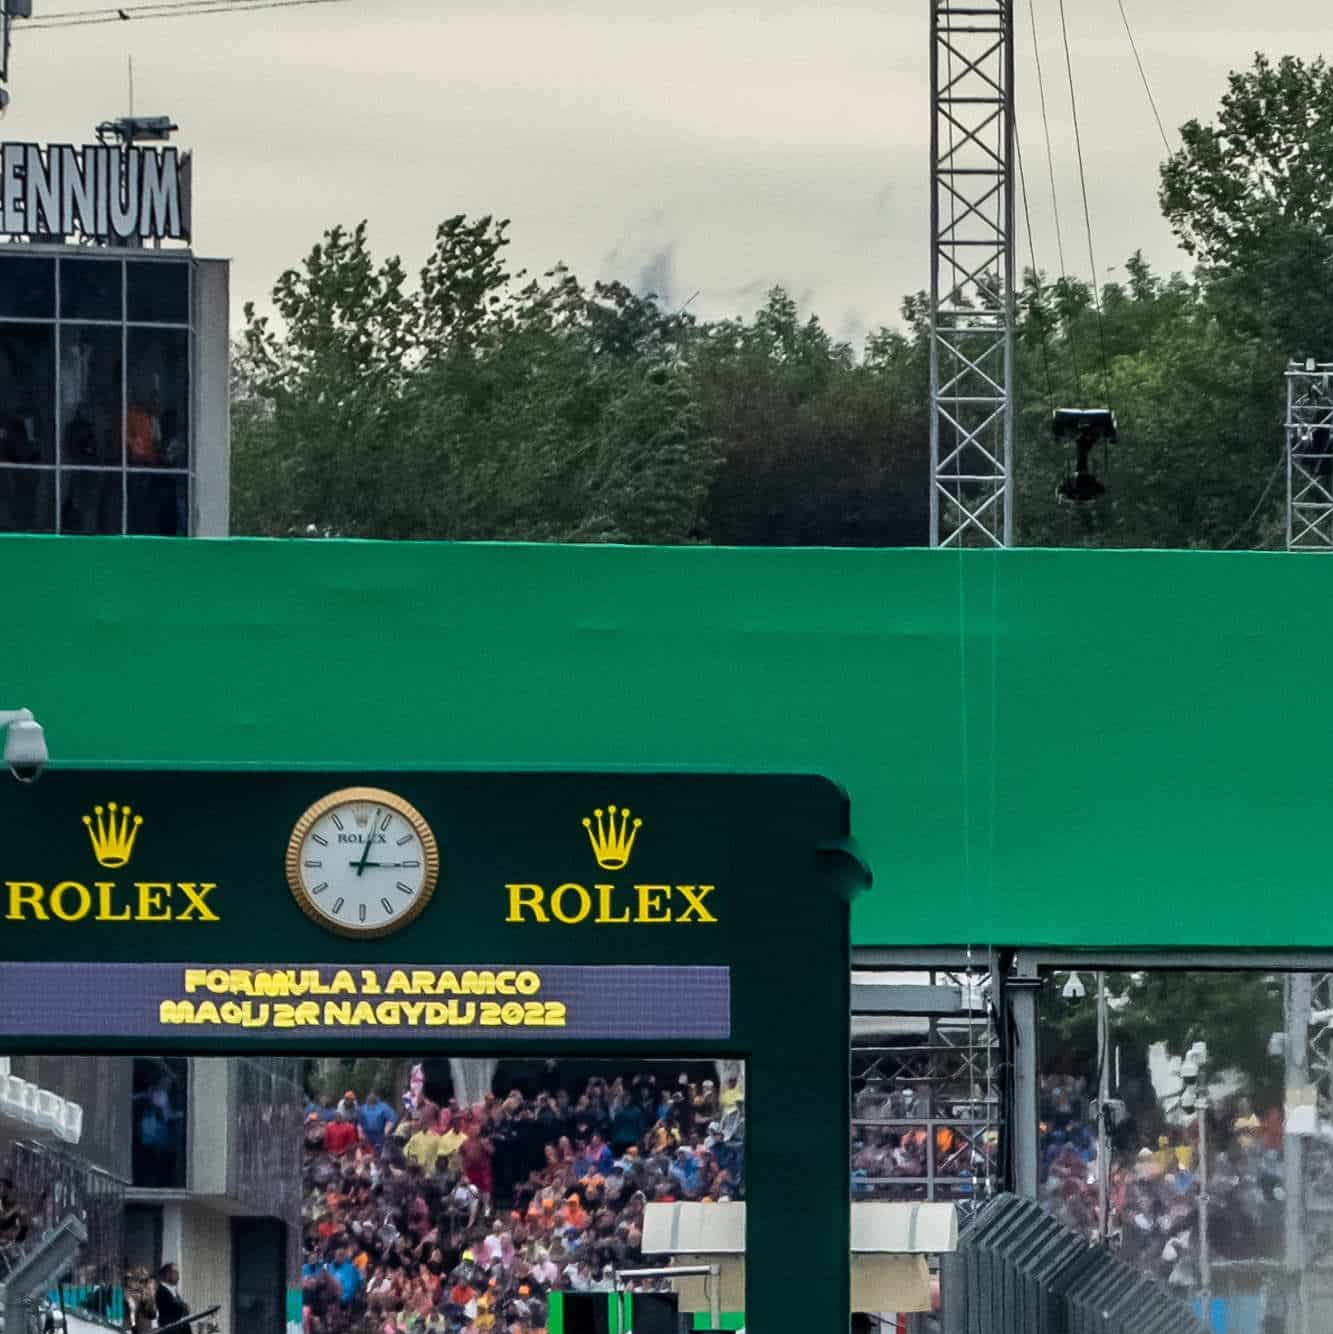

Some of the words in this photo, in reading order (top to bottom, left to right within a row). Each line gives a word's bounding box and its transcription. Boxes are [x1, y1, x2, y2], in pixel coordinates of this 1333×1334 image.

[0, 141, 181, 238] ENNIUM
[4, 881, 221, 921] ROLEX
[504, 883, 718, 924] ROLEX
[184, 969, 356, 997] FORMULA
[361, 970, 380, 994] 1
[385, 969, 541, 995] ARAMCO
[480, 1001, 567, 1026] 2022
